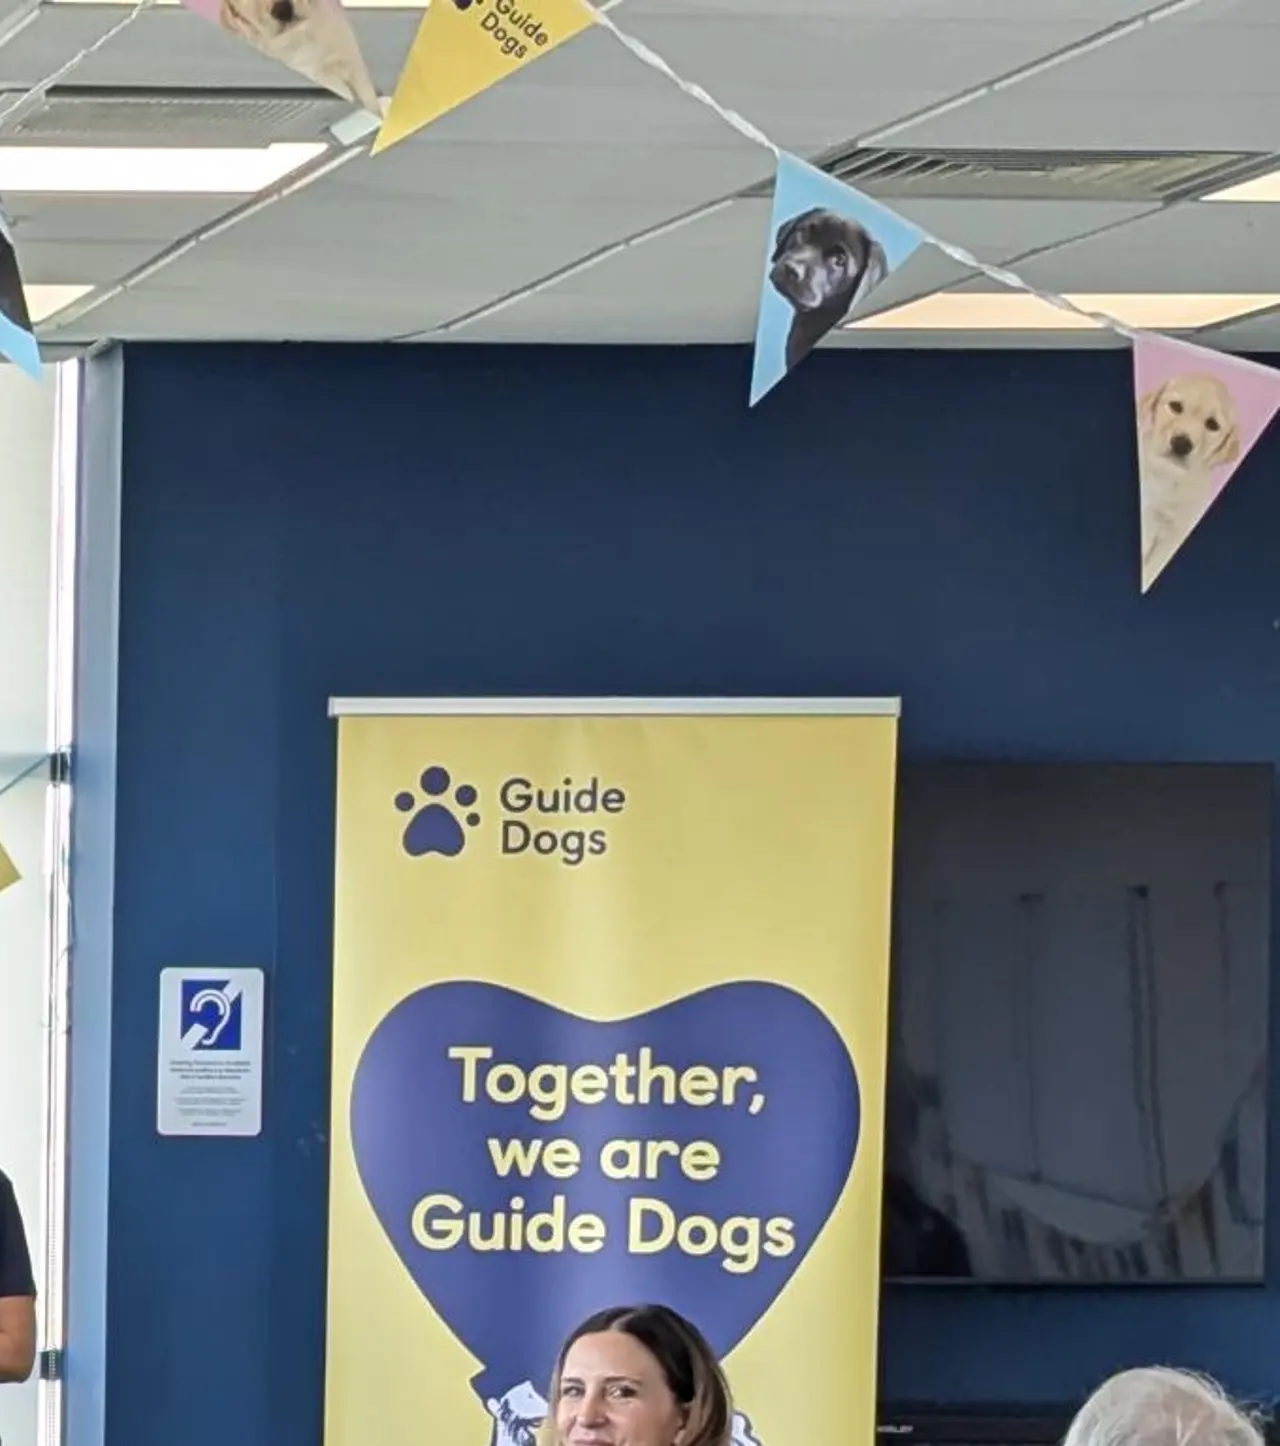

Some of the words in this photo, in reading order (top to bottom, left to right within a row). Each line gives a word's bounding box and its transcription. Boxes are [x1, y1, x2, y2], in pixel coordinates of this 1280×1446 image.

[479, 12, 528, 59] Dogs
[495, 0, 549, 47] Guide
[500, 776, 625, 814] Guide
[501, 819, 607, 866] Dogs
[448, 1046, 765, 1122] Together,
[487, 1136, 581, 1179] we
[600, 1138, 721, 1180] are
[411, 1193, 606, 1253] Guide
[627, 1197, 796, 1274] Dogs
